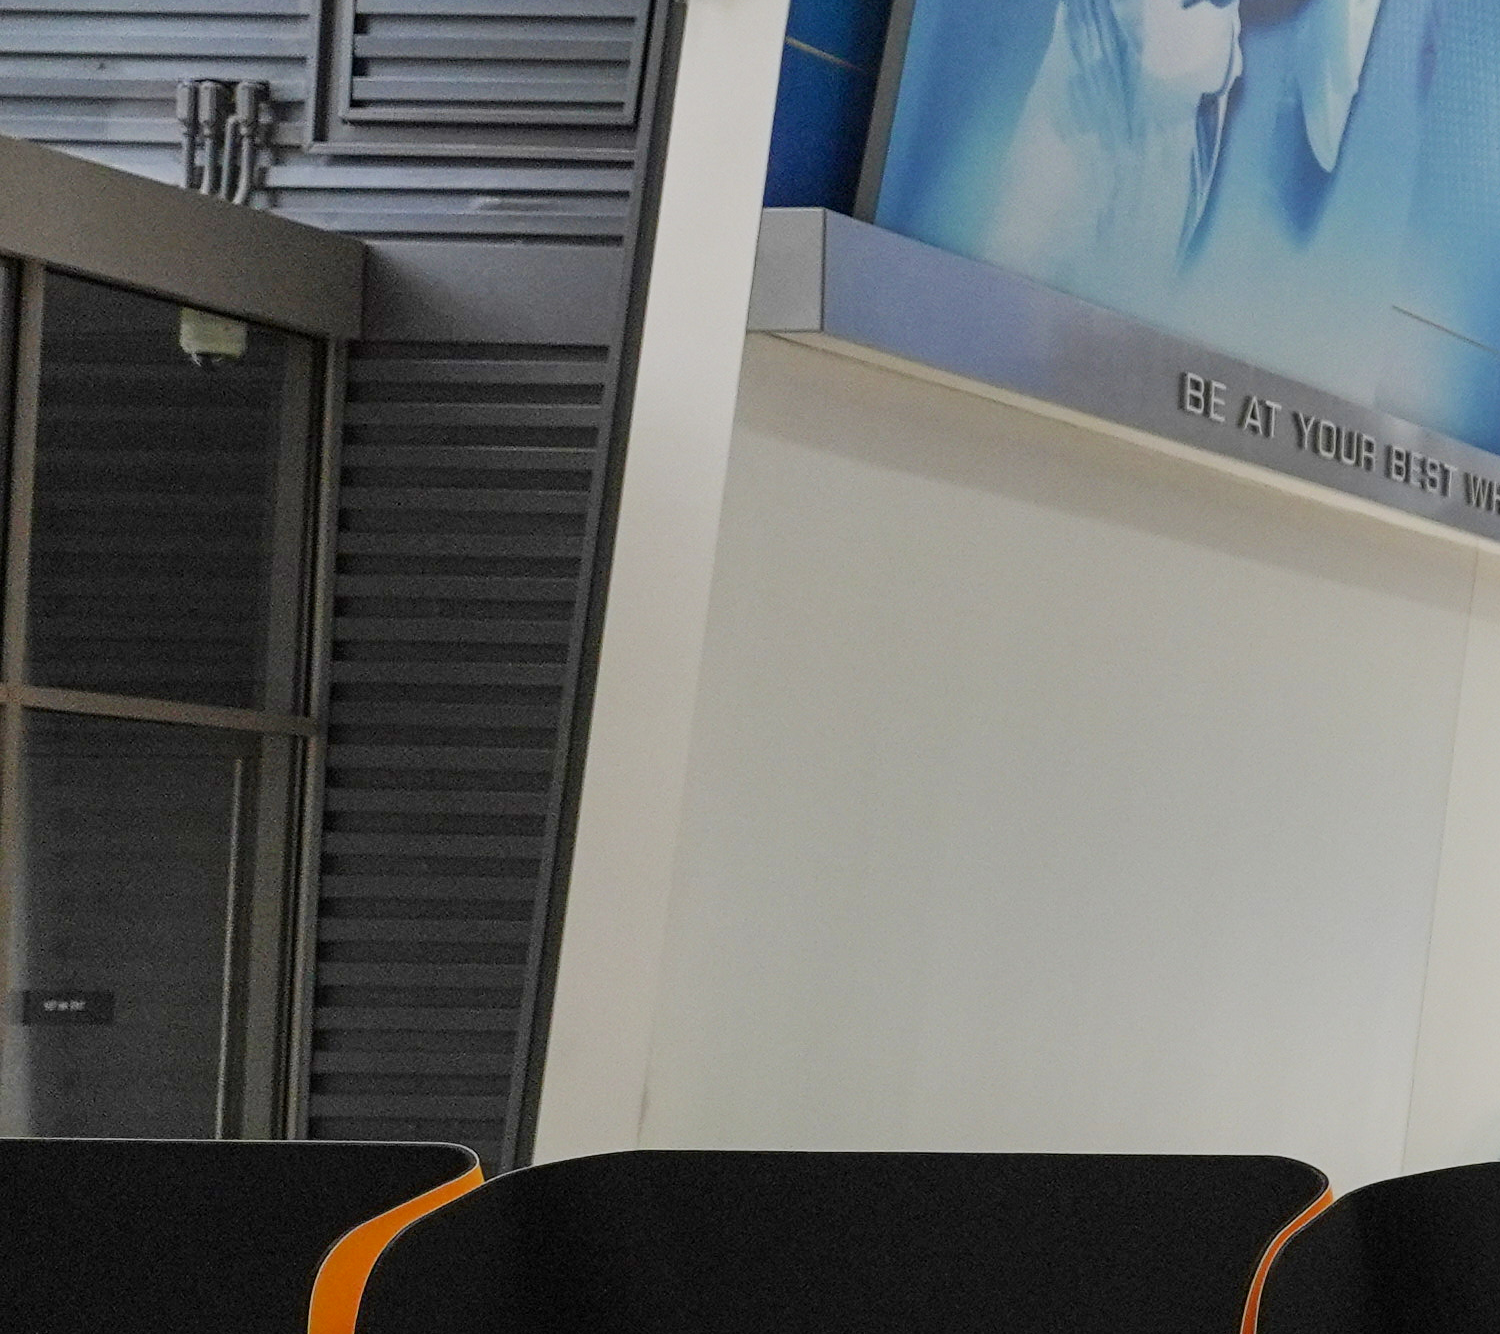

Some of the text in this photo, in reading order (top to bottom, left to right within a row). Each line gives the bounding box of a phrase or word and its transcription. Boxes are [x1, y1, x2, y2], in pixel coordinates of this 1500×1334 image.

[1184, 372, 1227, 423] BE
[1243, 396, 1282, 439] AT
[1297, 412, 1376, 471] YOUR
[1389, 445, 1458, 497] BEST
